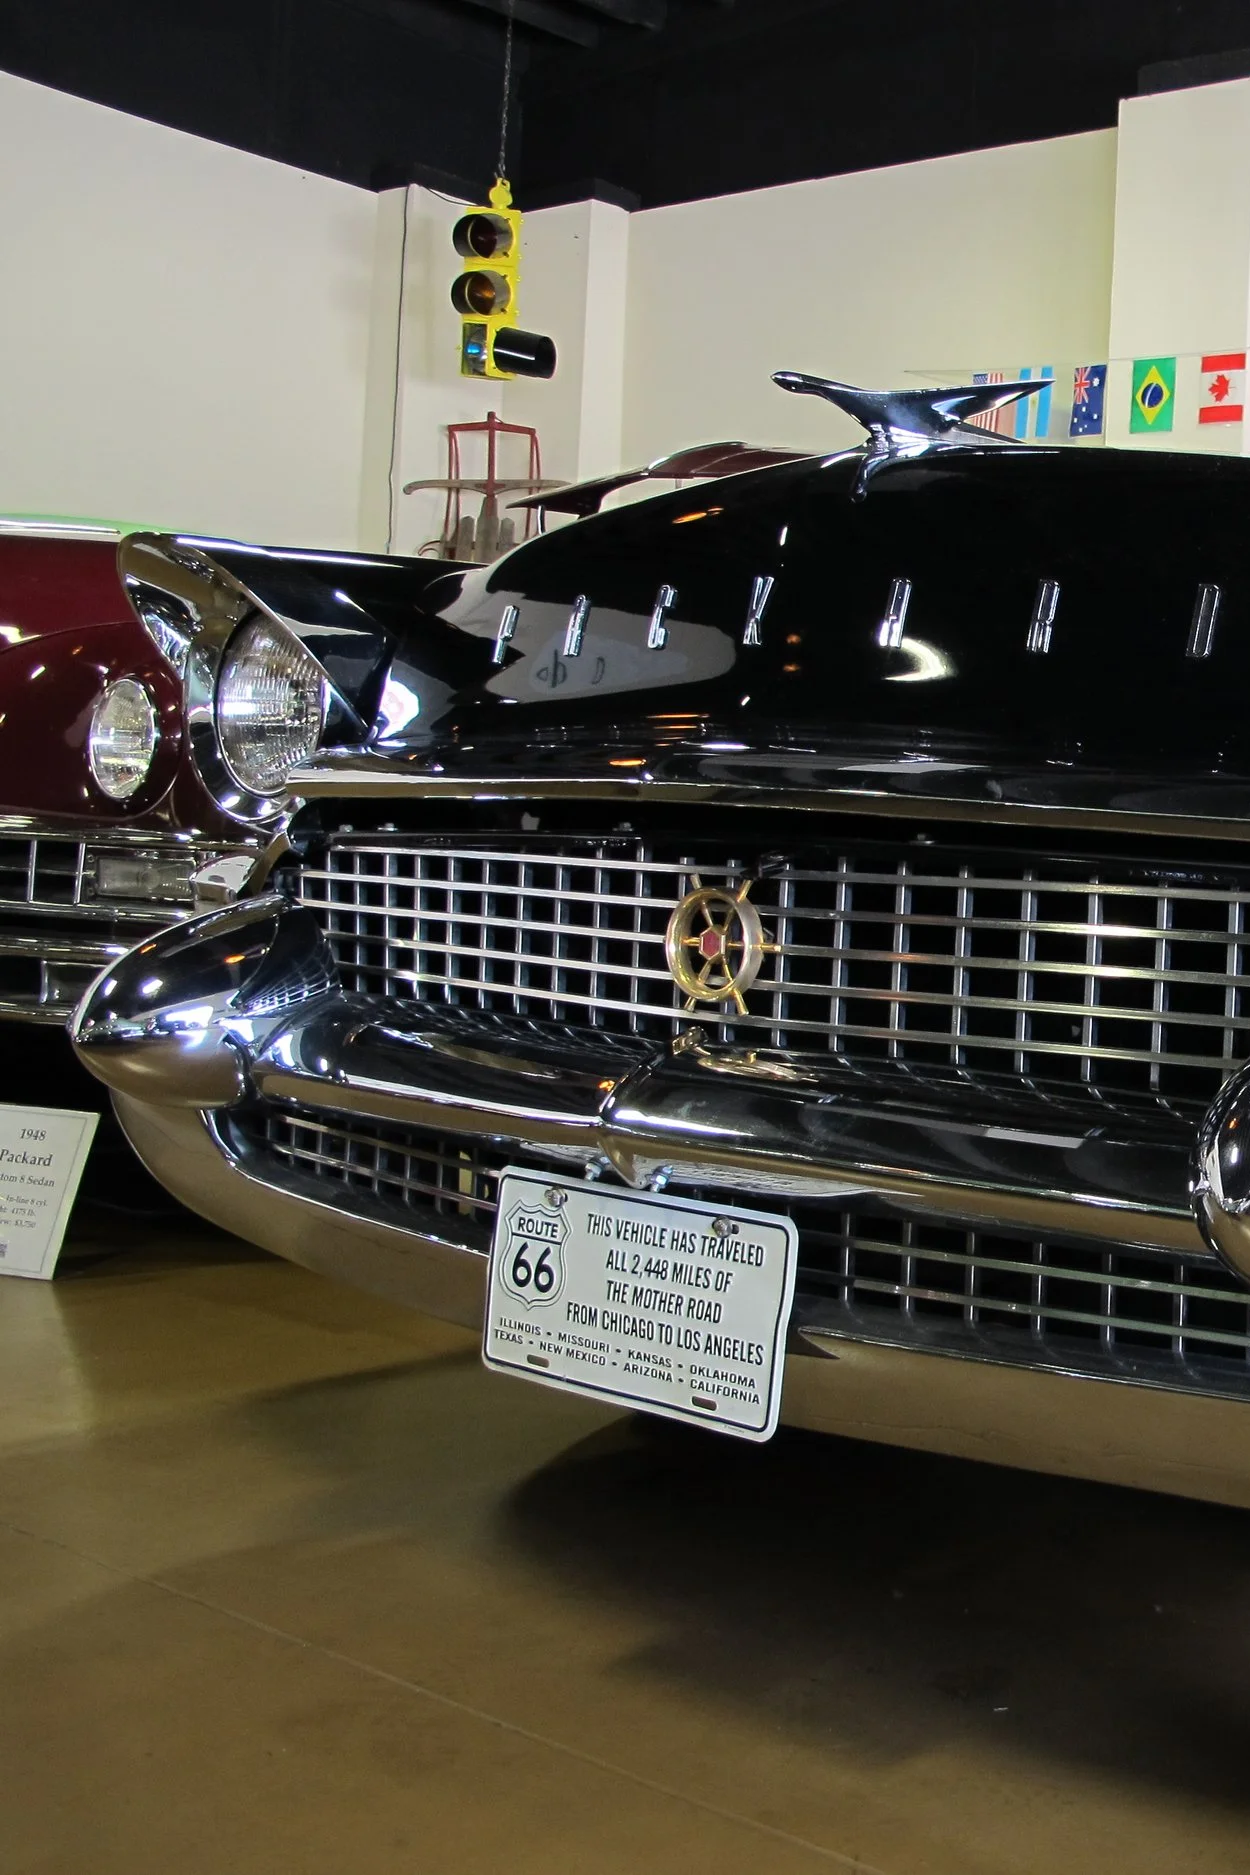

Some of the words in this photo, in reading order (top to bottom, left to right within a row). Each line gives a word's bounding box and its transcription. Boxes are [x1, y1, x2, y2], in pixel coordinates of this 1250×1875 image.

[493, 576, 1222, 664] PACKARD
[0, 1148, 53, 1167] Packard
[20, 1128, 47, 1141] 1948
[27, 1176, 55, 1187] Sedan
[518, 1216, 558, 1239] ROUTE
[587, 1213, 612, 1238] THIS
[616, 1220, 666, 1248] VEHICLE
[671, 1230, 696, 1254] HAS
[701, 1235, 764, 1267] TRAVELED
[512, 1242, 554, 1293] 66
[606, 1249, 628, 1272] ALL
[632, 1254, 669, 1281] 2,448
[671, 1262, 711, 1290] MILES
[714, 1270, 733, 1293] OF
[606, 1280, 628, 1304] THE
[632, 1285, 683, 1317] MOTHER
[687, 1297, 722, 1324] ROAD
[500, 1317, 541, 1336] ILLINOIS
[558, 1331, 610, 1353] MISSOURI
[628, 1350, 672, 1368] KANSAS
[689, 1364, 756, 1389] OKLAHOMA
[566, 1301, 598, 1325] FROM
[602, 1310, 654, 1342] CHICAGO
[658, 1322, 673, 1345] TO
[677, 1326, 701, 1352] LOS
[703, 1333, 764, 1366] ANGELES
[494, 1329, 523, 1345] TEXAS
[539, 1341, 562, 1357] NEW
[566, 1348, 606, 1366] MEXICO
[623, 1362, 673, 1383] ARIZONA
[690, 1378, 760, 1404] CALIFORNIA
